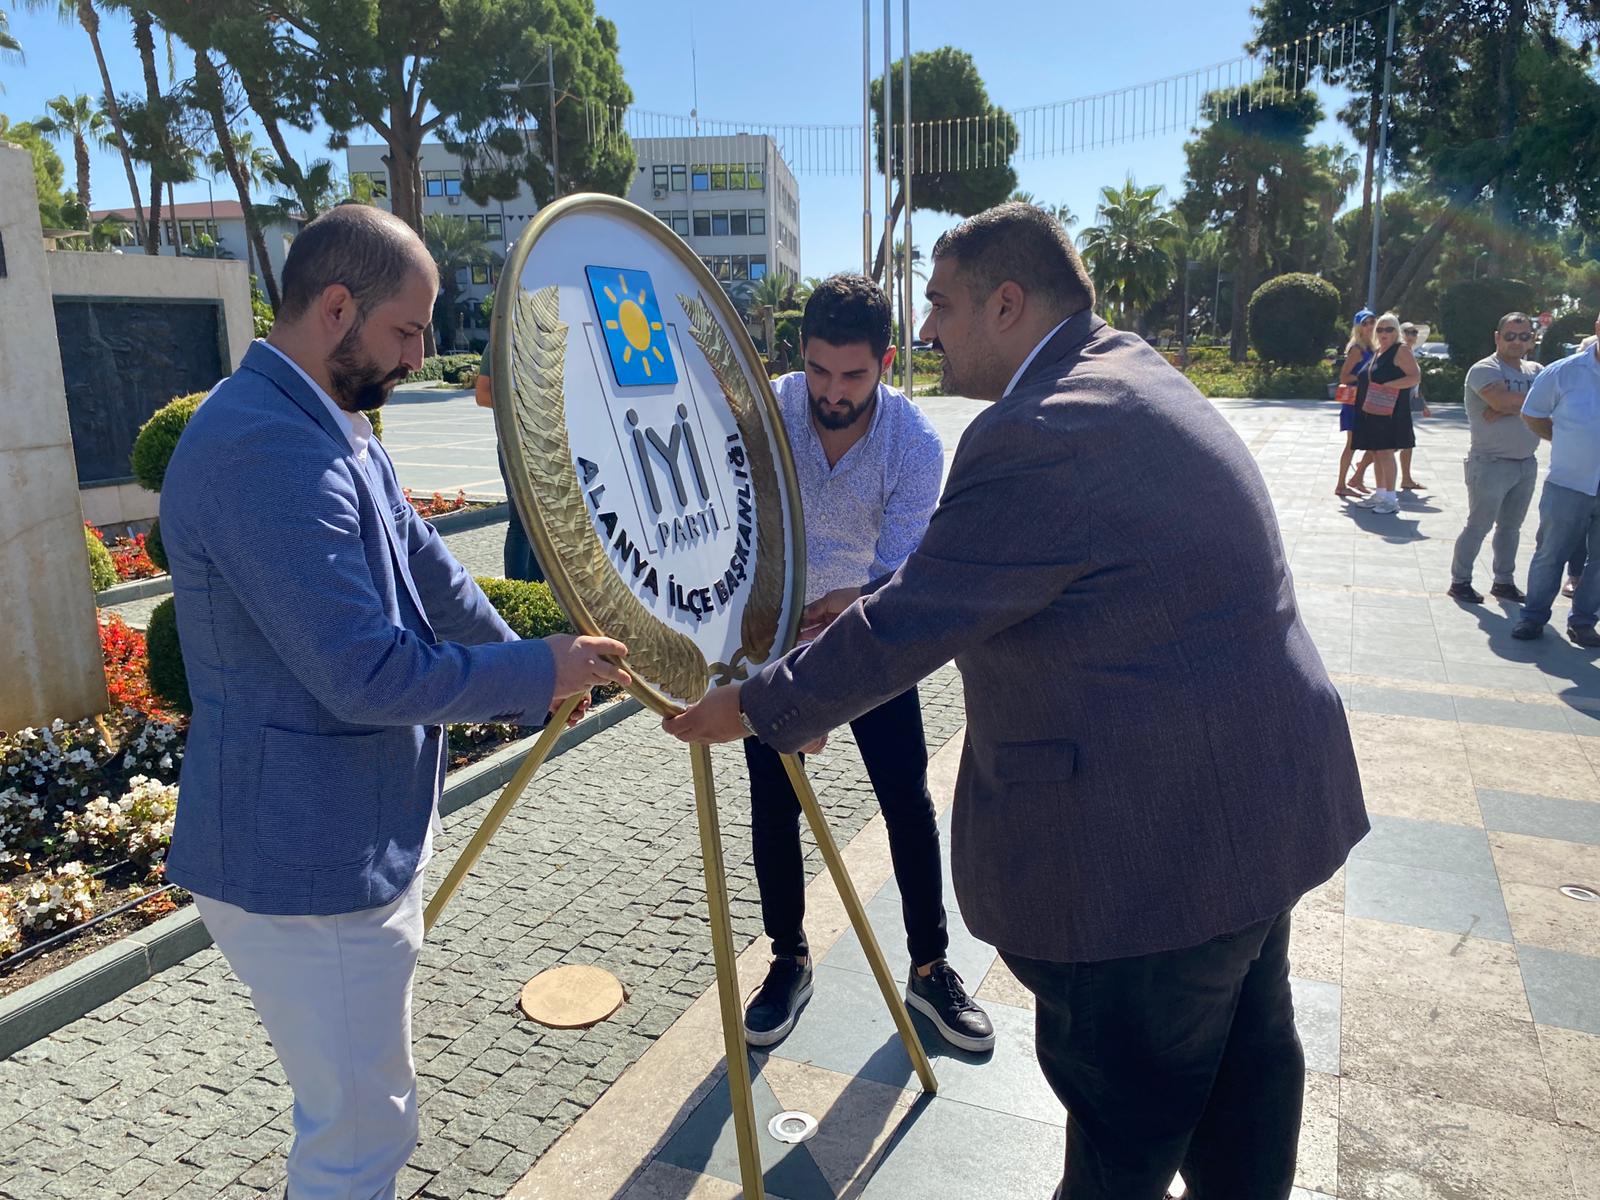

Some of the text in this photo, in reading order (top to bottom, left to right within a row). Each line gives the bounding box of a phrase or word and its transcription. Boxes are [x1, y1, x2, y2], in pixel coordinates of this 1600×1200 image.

[626, 403, 710, 515] İYİ
[577, 456, 659, 597] ALANYA
[668, 574, 714, 621] İLÇE
[658, 502, 719, 548] PARTİ
